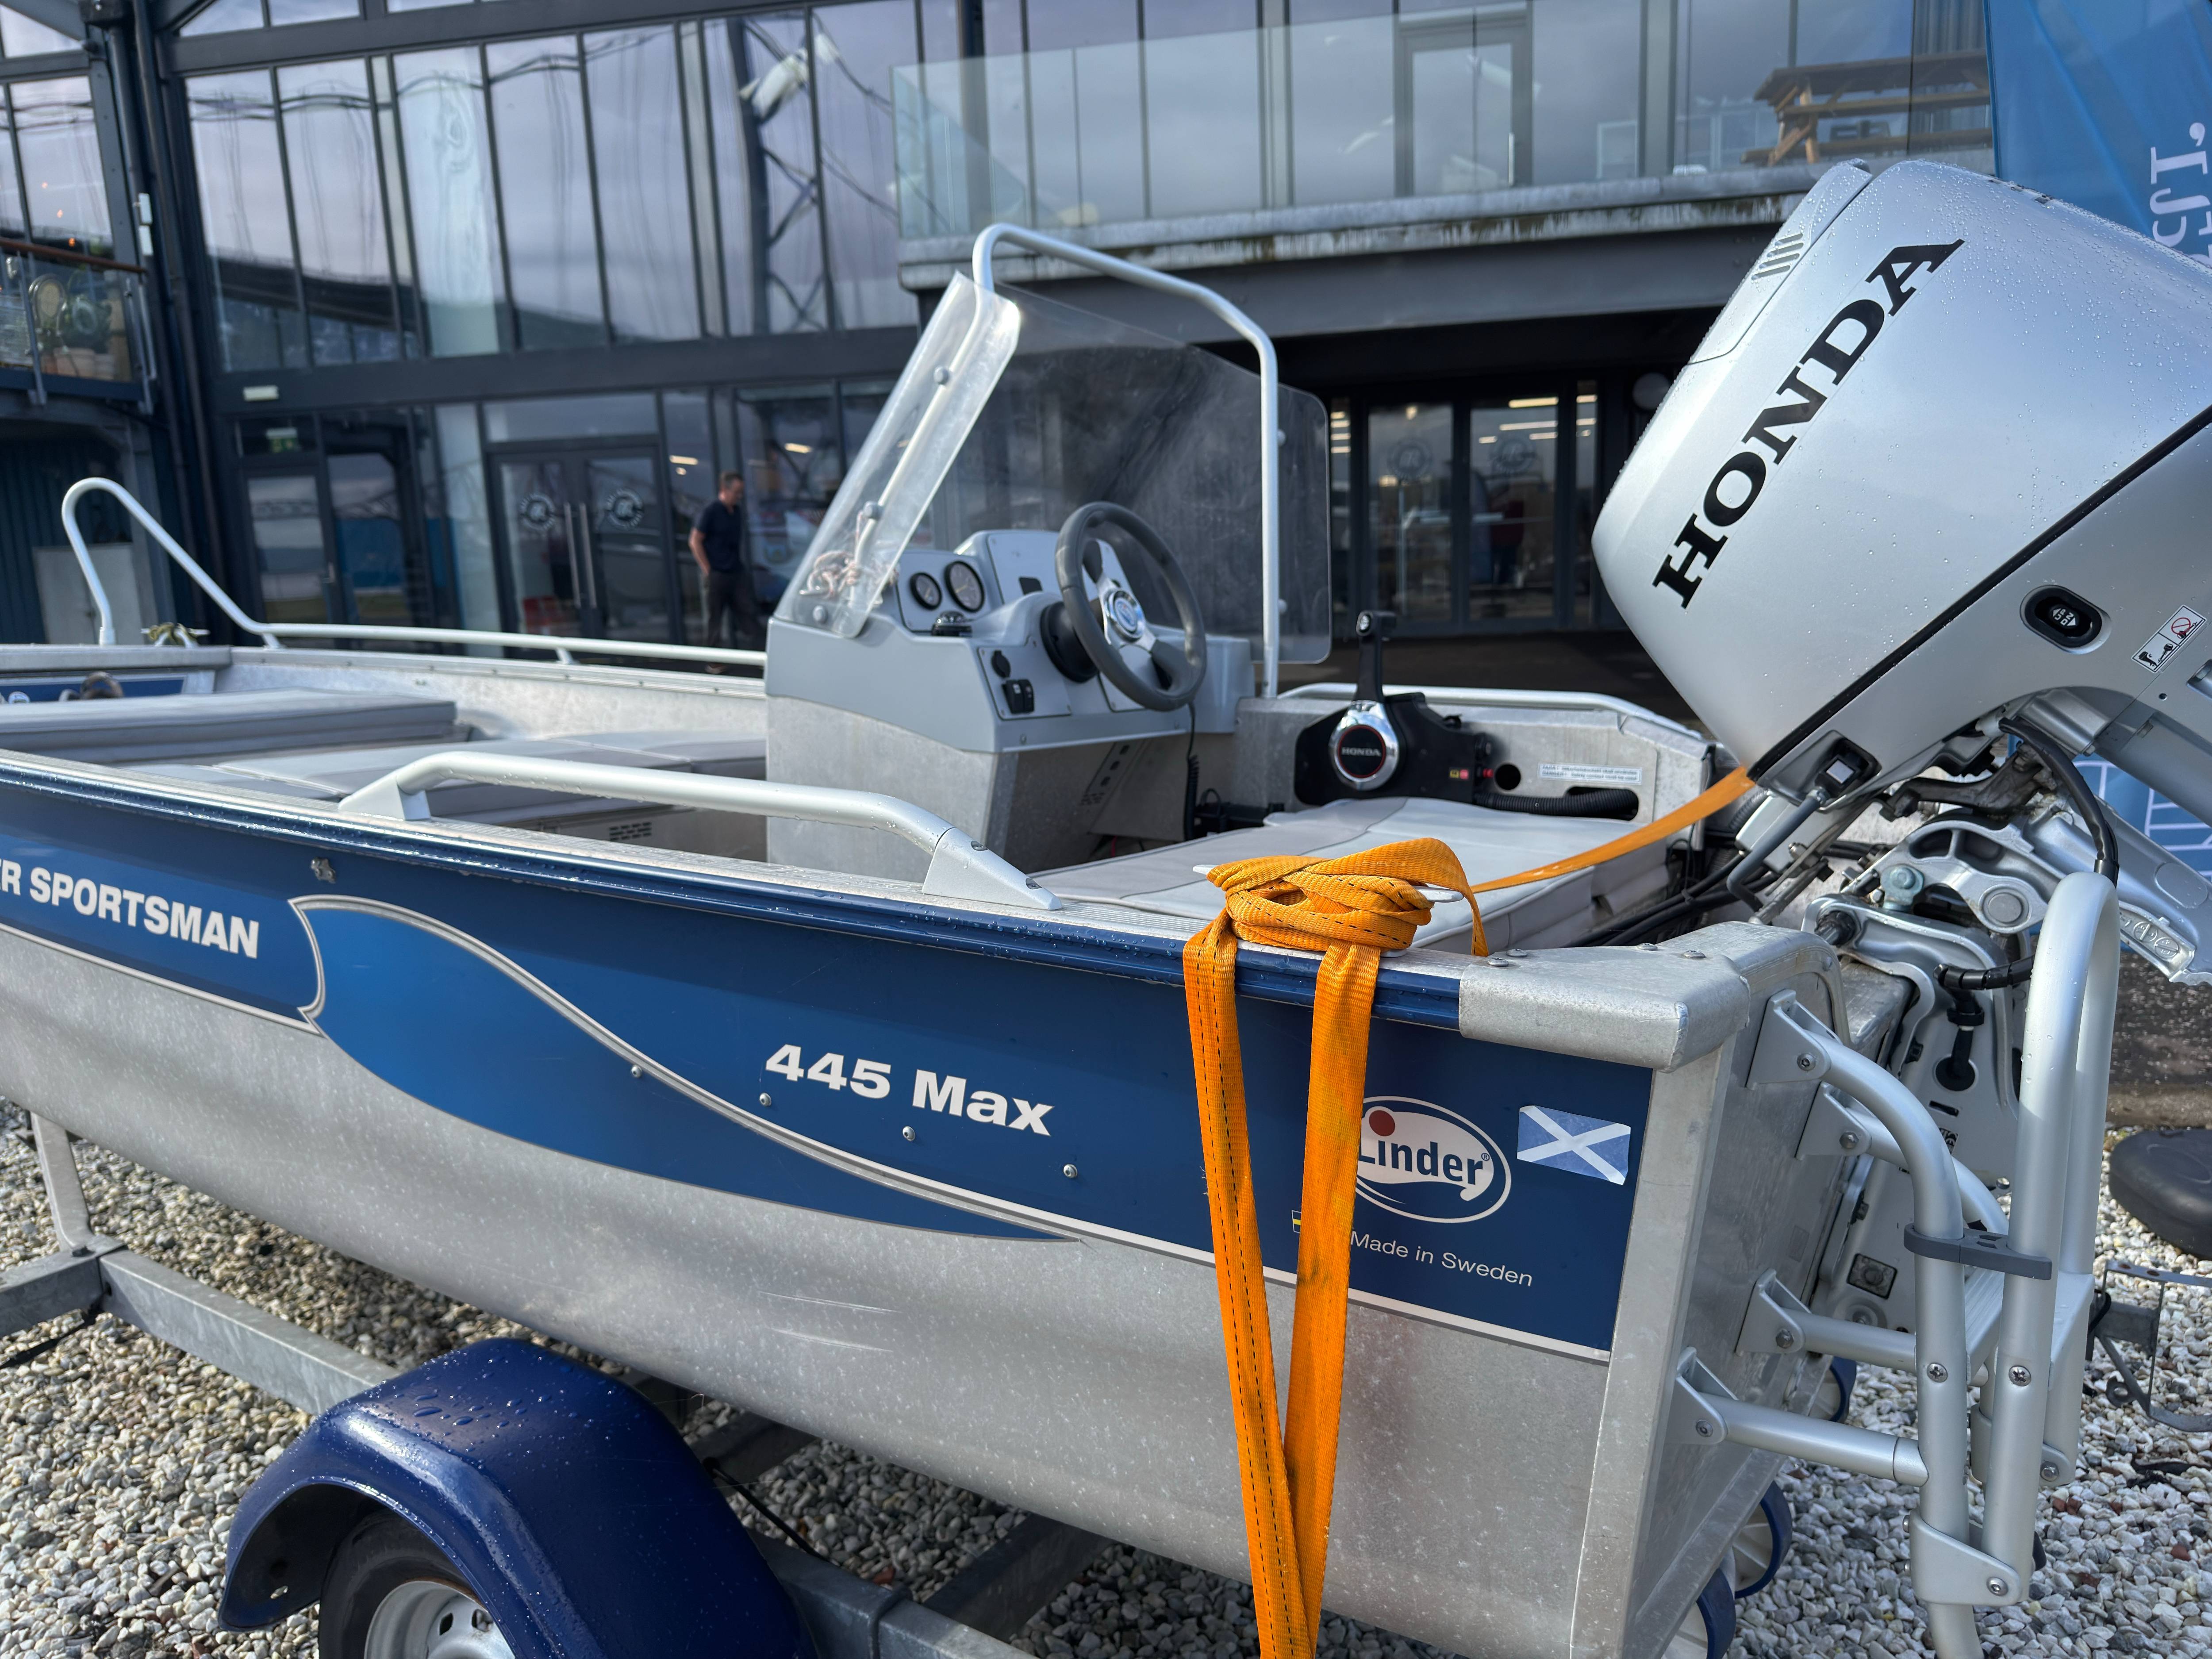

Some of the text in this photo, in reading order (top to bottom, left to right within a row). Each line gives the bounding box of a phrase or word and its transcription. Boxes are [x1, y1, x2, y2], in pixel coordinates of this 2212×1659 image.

[1651, 238, 1966, 610] HONDA
[2054, 608, 2066, 621] UP
[2060, 612, 2074, 626] DN
[1341, 747, 1381, 757] HONDA
[0, 858, 259, 959] R SPORTSMAN
[765, 1044, 1055, 1137] 445 Max
[1350, 1231, 1533, 1287] Made in Sweden
